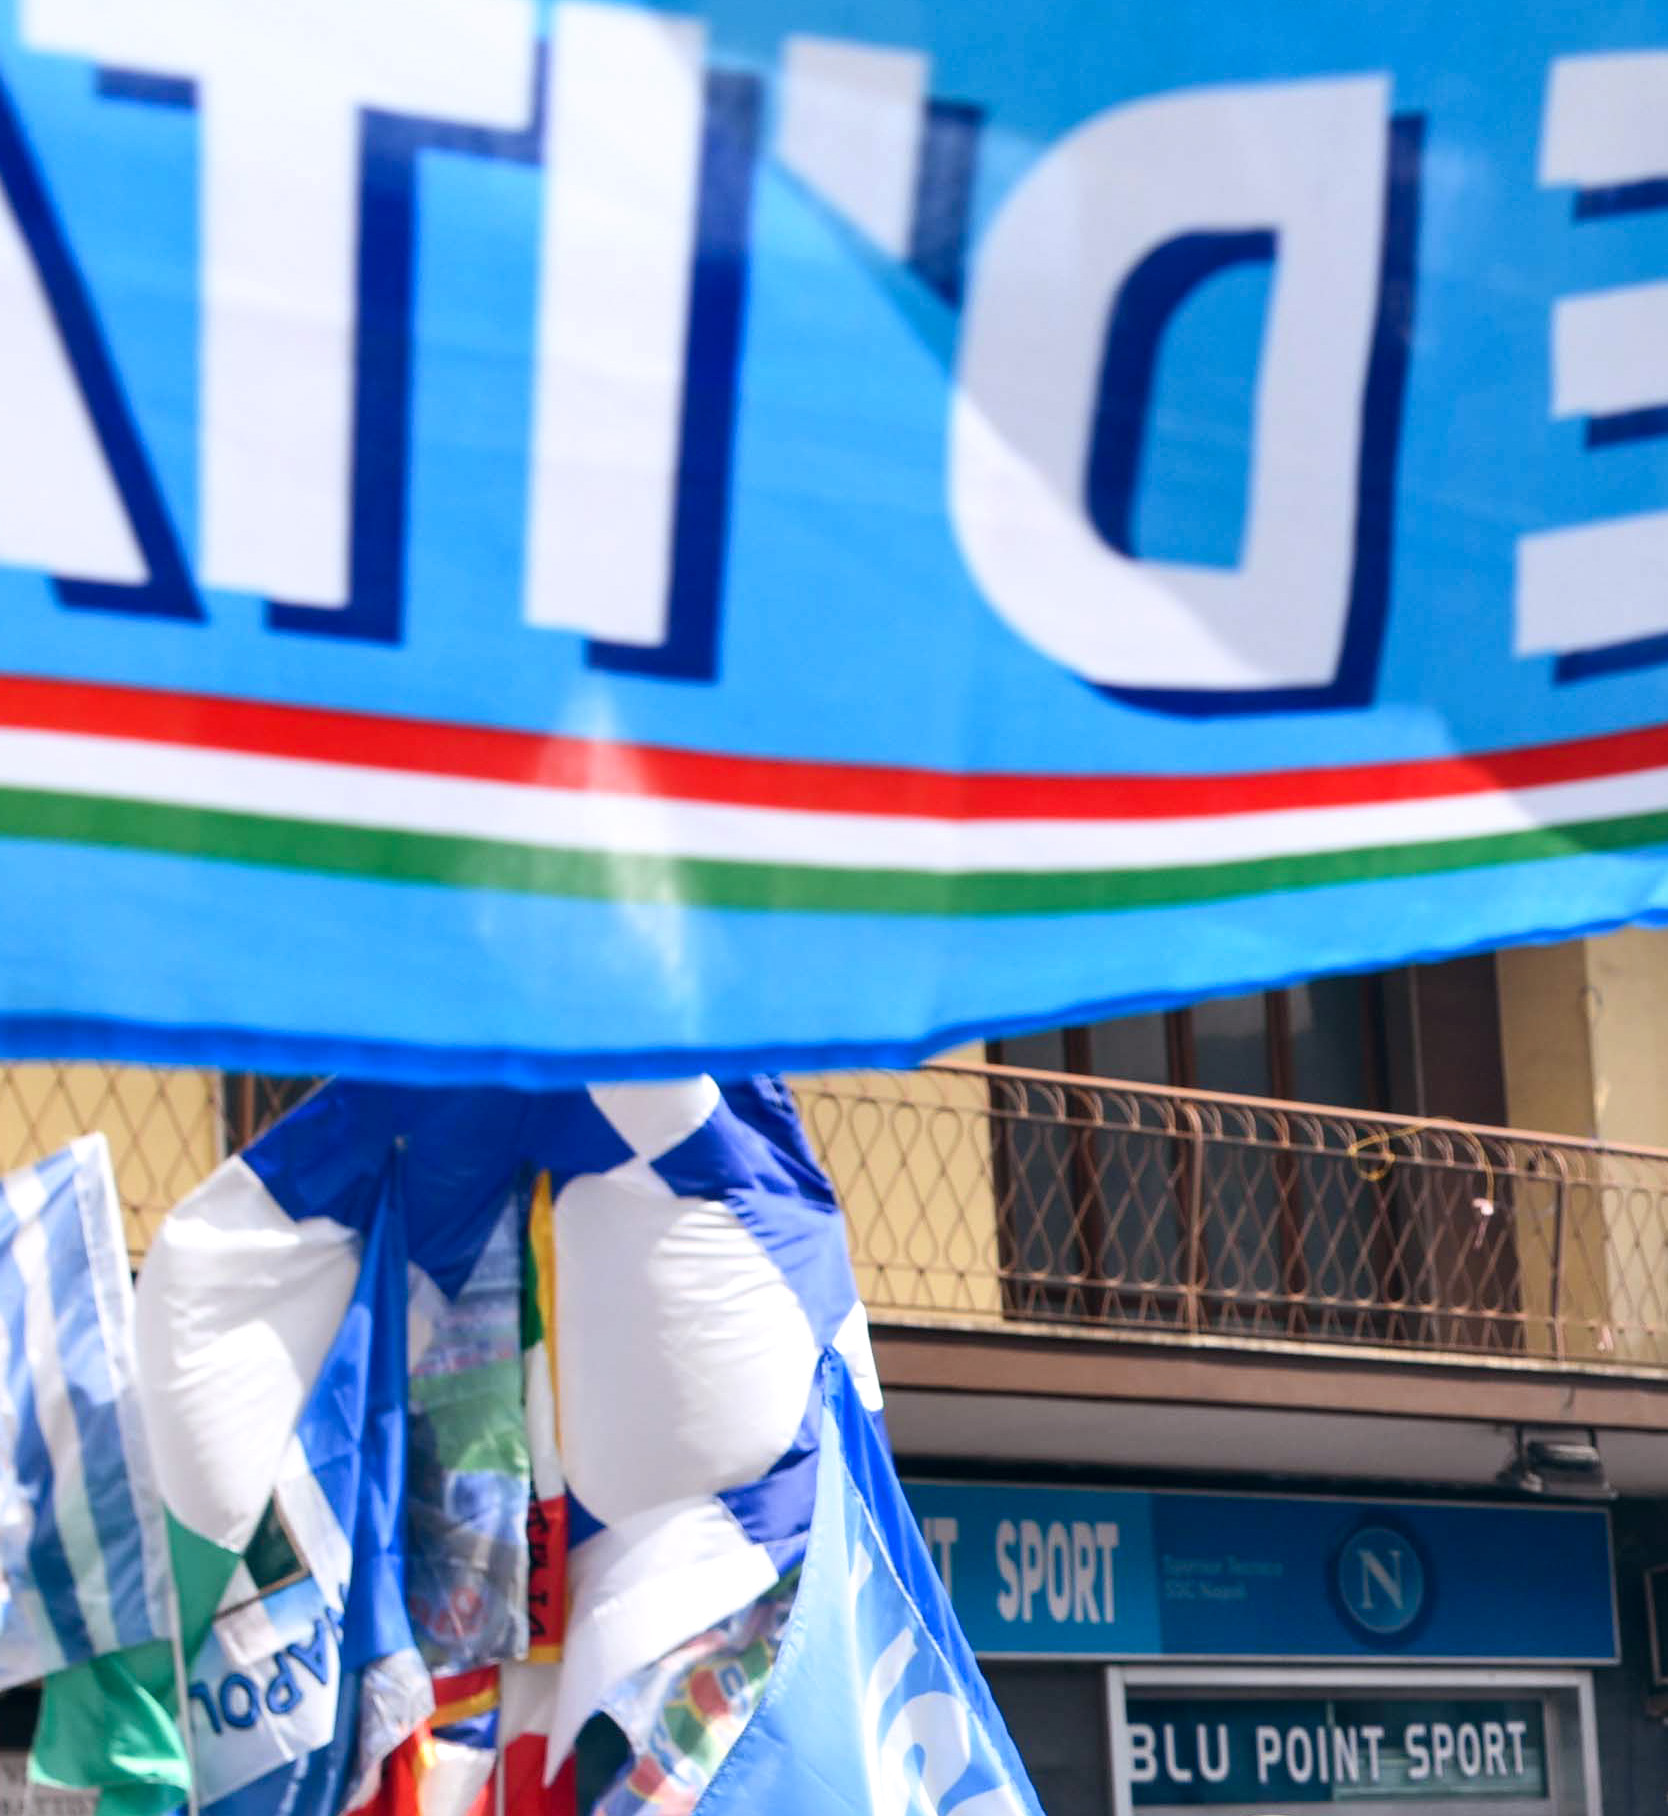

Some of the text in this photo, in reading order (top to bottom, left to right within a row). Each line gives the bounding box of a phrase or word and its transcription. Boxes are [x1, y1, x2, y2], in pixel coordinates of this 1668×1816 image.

[996, 1519, 1119, 1624] SPORT
[1357, 1549, 1405, 1610] N
[1132, 1722, 1526, 1783] BLU POINT SPORT
